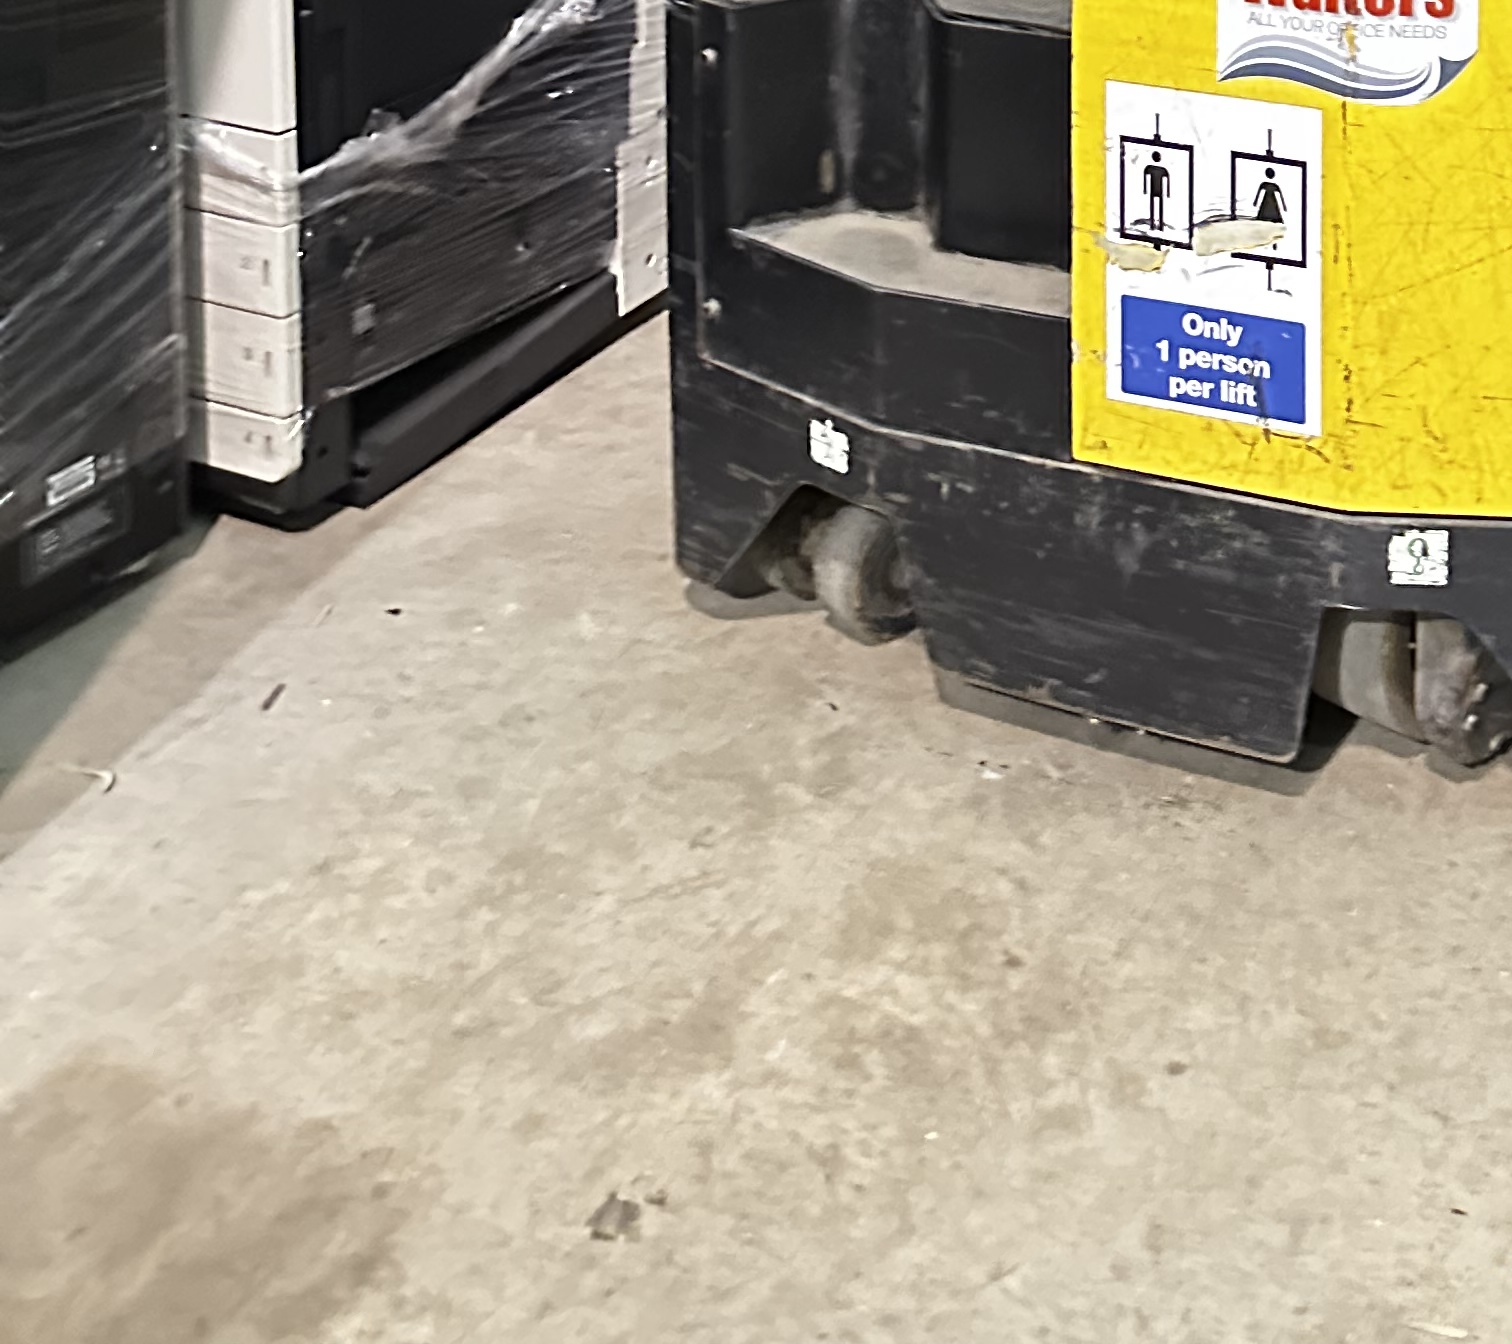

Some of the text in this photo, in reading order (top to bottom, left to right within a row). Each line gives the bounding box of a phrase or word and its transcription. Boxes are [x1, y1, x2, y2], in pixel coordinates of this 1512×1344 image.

[1246, 11, 1276, 28] ALL
[1280, 15, 1325, 33] YOUR
[1388, 24, 1449, 40] NEEDS
[1181, 312, 1243, 347] Only
[1155, 339, 1271, 379] 1 person
[1168, 375, 1258, 407] per lift
